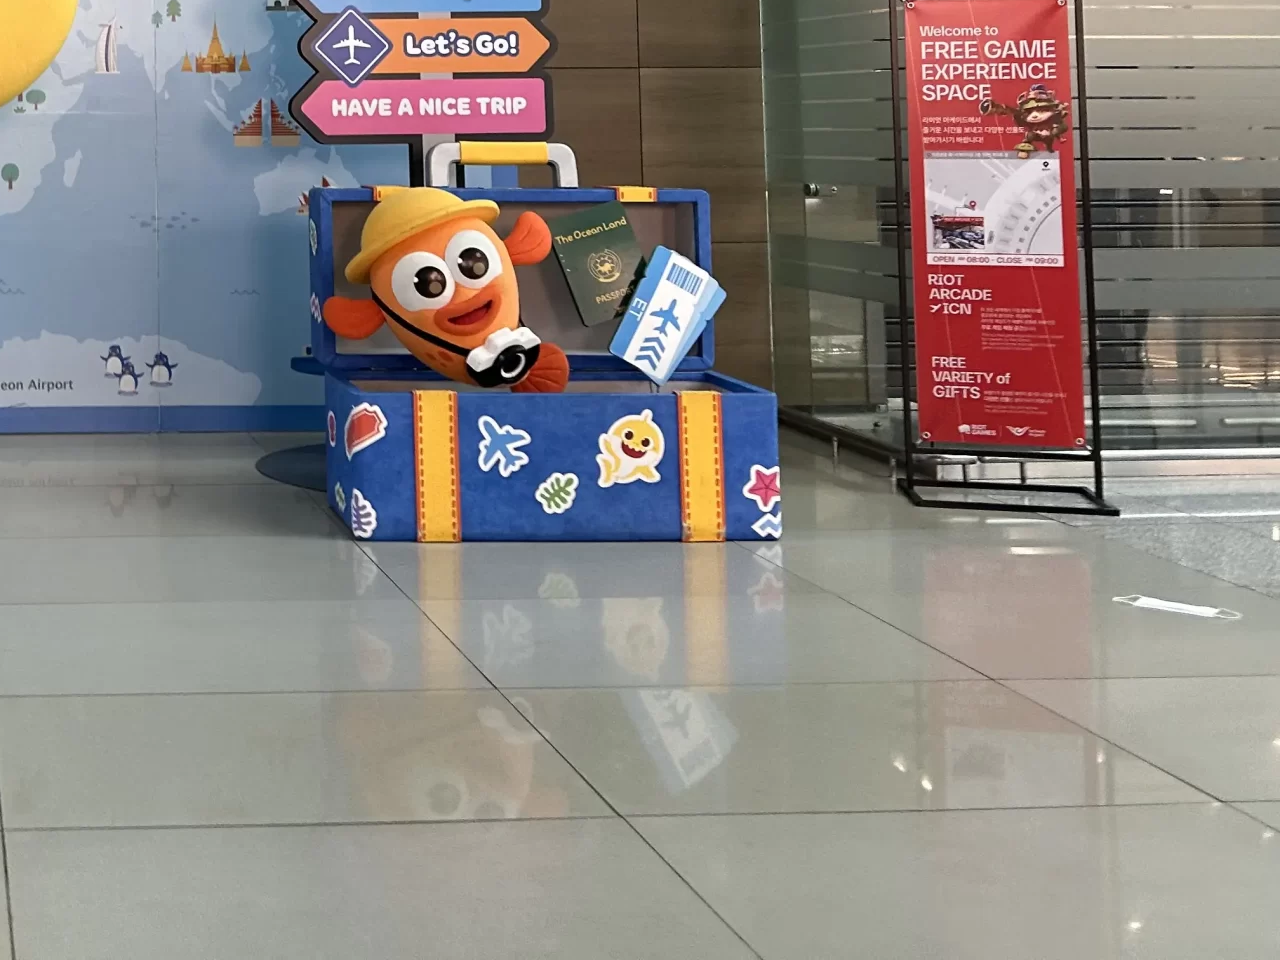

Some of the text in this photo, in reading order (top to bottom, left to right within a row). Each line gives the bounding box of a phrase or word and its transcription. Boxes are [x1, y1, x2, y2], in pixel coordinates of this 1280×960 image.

[919, 25, 999, 37] Welcome to
[406, 34, 517, 55] Let's Go!
[921, 40, 1057, 59] FREE GAME
[922, 62, 1057, 80] EXPERIENCE
[922, 84, 992, 101] SPACE
[331, 96, 527, 117] HAVE A NICE TRIP
[554, 216, 628, 245] The Ocean Land
[932, 255, 955, 263] OPEN
[966, 256, 990, 264] 08:00
[1034, 257, 1059, 265] 09:00
[927, 273, 965, 286] RIOT
[929, 288, 993, 301] ARCADE
[629, 297, 648, 321] ET
[943, 303, 972, 315] ICN
[931, 356, 966, 369] FREE
[932, 371, 1011, 385] VARIETY of
[28, 378, 74, 393] Airport
[932, 385, 981, 399] GIFTS
